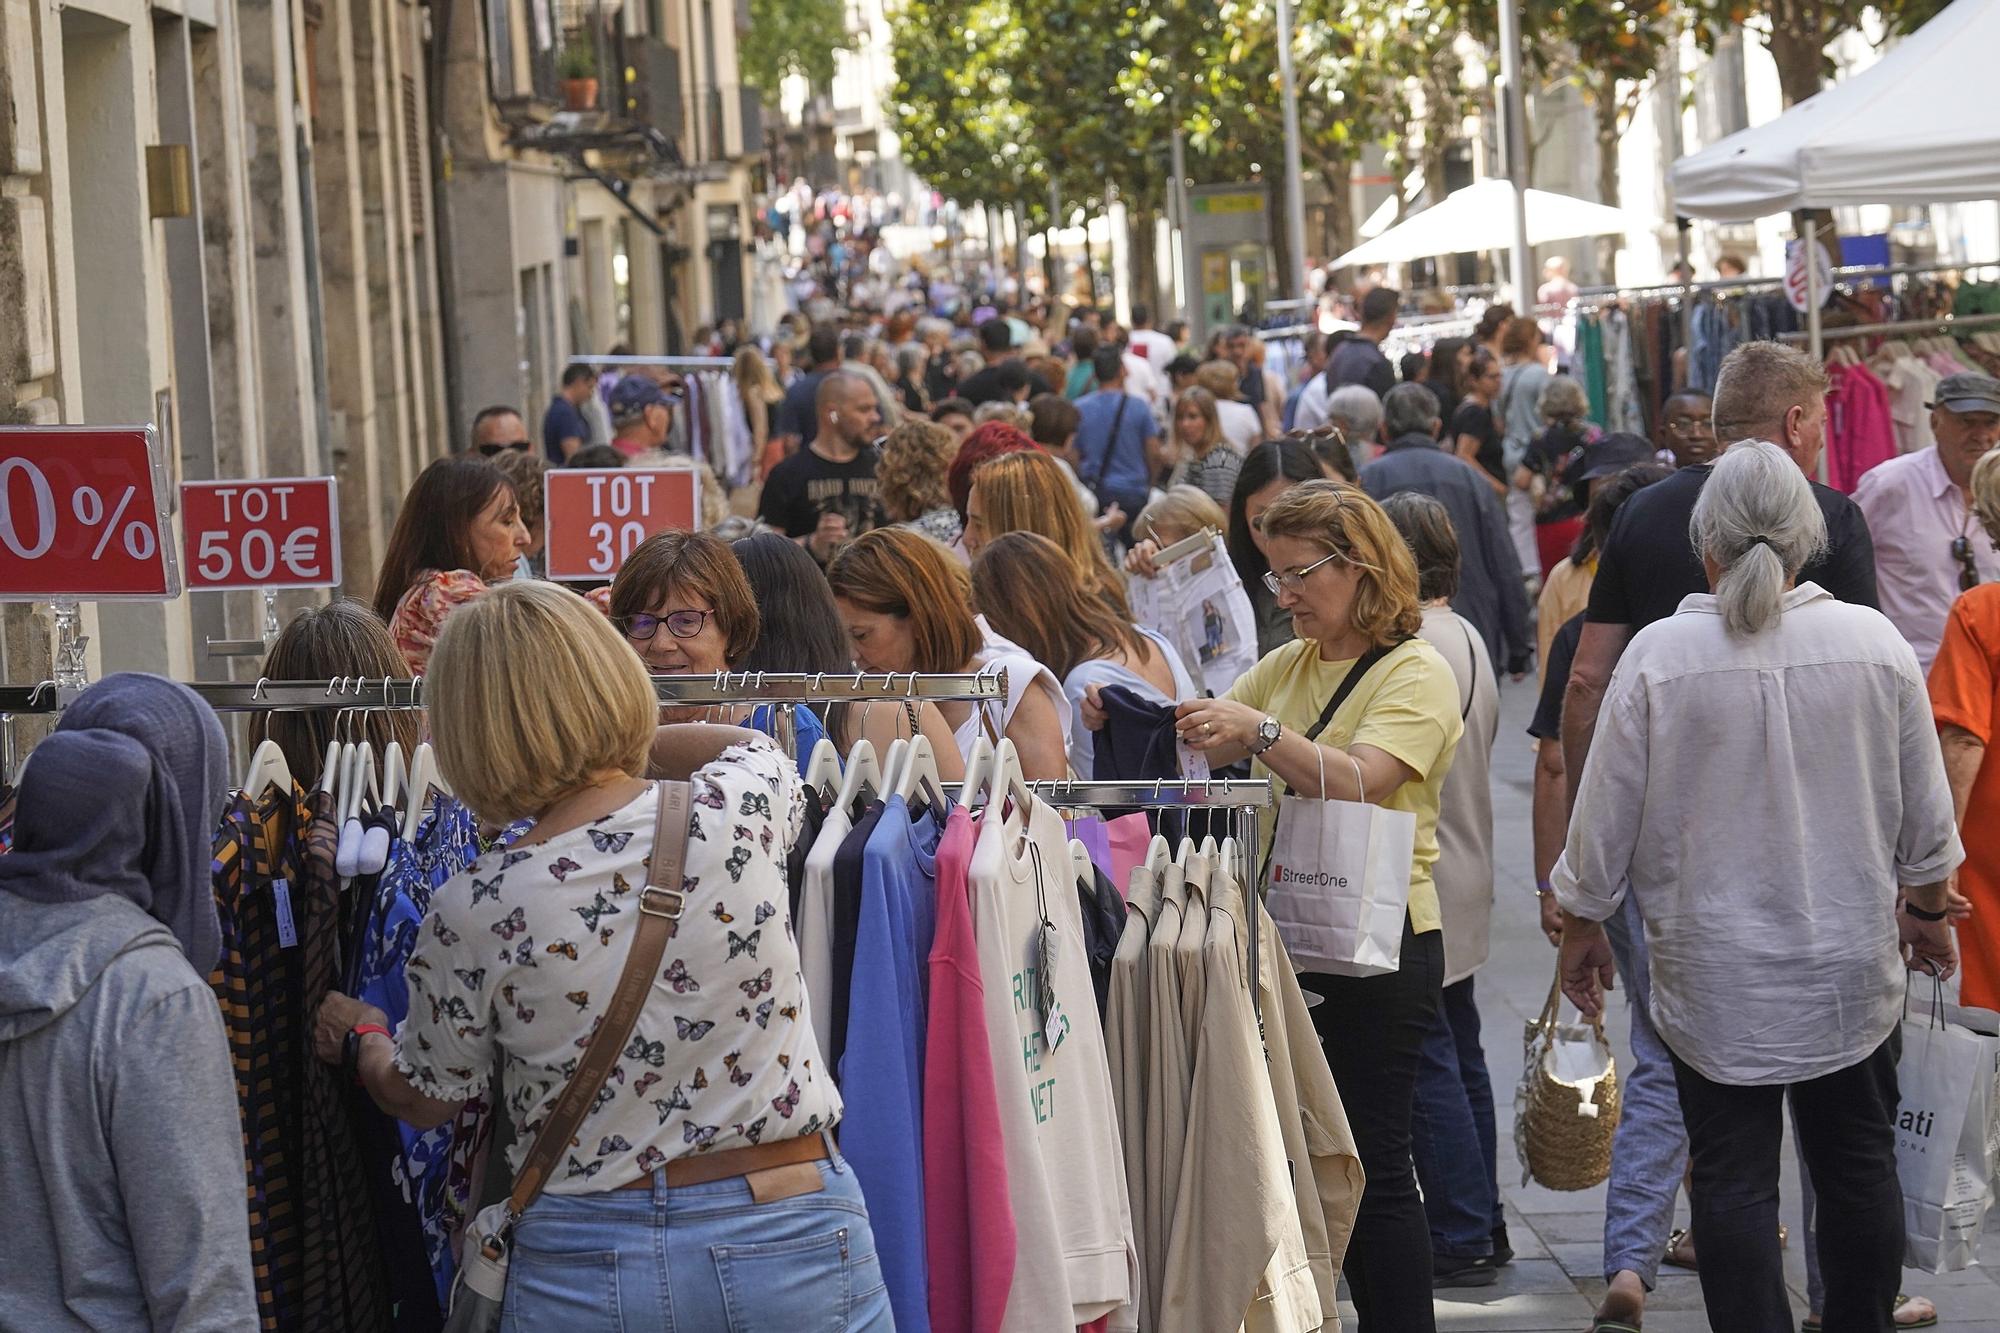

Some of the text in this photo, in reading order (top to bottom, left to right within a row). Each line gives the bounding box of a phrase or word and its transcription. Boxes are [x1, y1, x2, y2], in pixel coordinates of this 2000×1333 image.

[214, 486, 295, 523] TOT
[589, 475, 655, 517] TOT
[198, 526, 321, 581] 50€
[588, 521, 645, 573] 30
